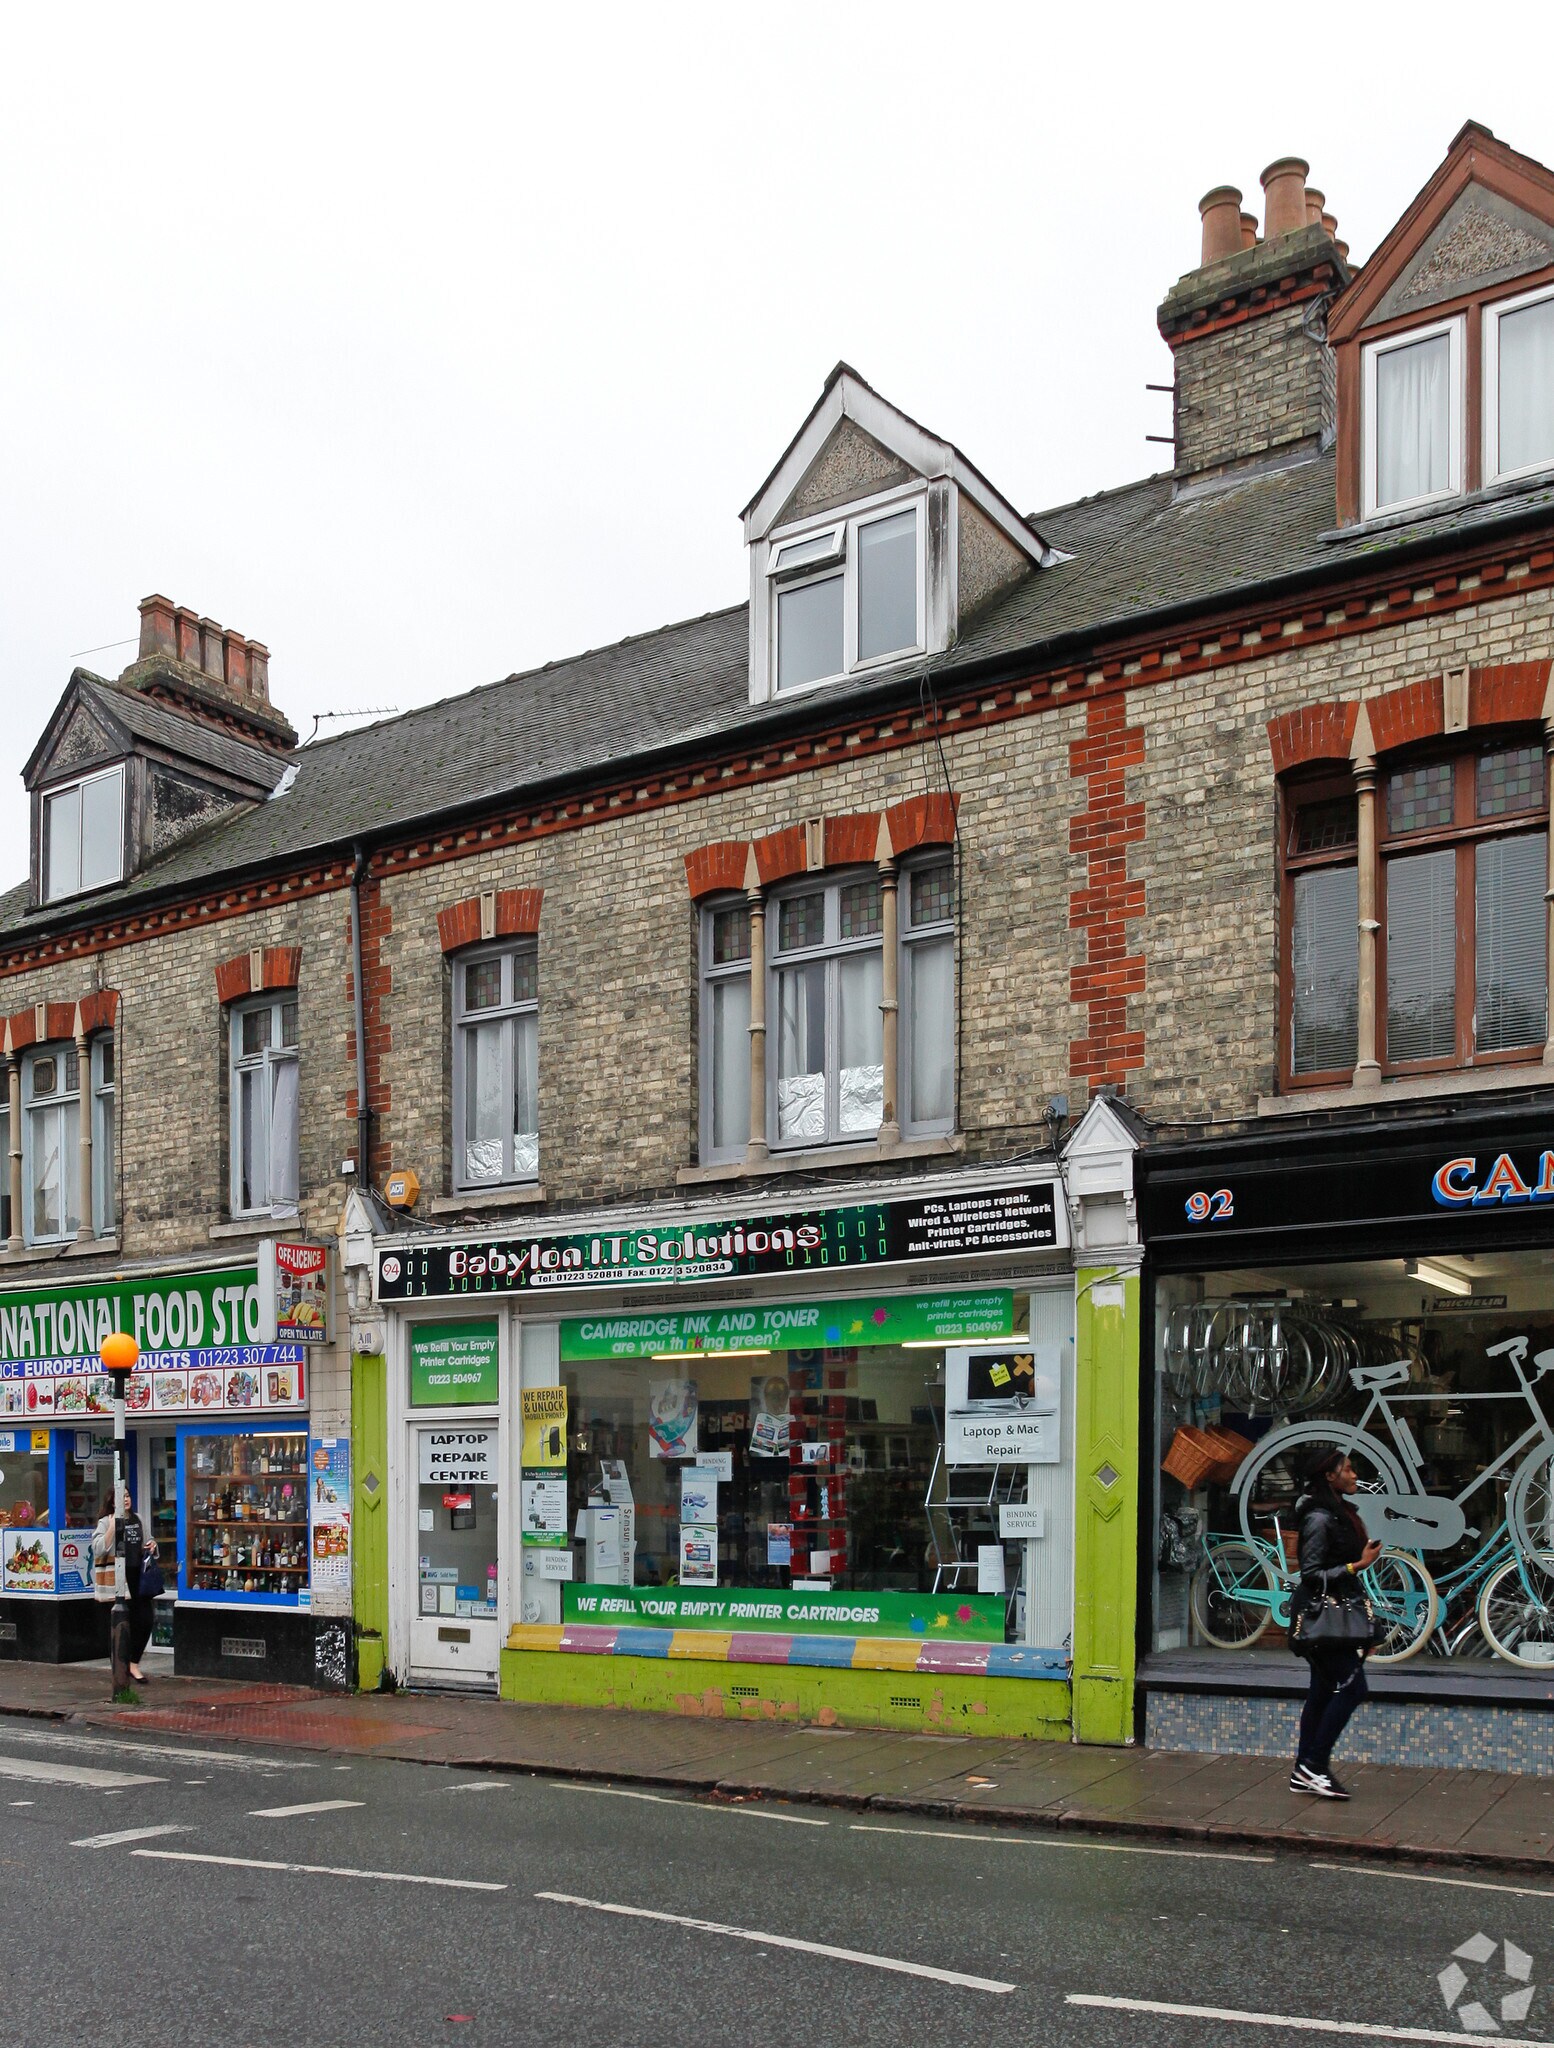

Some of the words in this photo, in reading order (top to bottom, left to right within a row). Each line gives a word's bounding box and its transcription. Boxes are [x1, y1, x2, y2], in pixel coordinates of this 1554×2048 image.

[390, 1183, 404, 1194] ADT
[948, 1199, 992, 1212] Laptops
[1185, 1189, 1234, 1223] 92
[908, 1217, 941, 1227] Wired
[943, 1215, 951, 1224] &
[952, 1210, 1002, 1223] Wireless
[1005, 1204, 1051, 1217] Network
[927, 1226, 966, 1237] Printer
[965, 1235, 979, 1245] PC
[981, 1229, 1052, 1244] Accessories
[278, 1246, 322, 1269] OFF-LICENCE
[449, 1244, 584, 1278] Babylon
[591, 1236, 629, 1266] I.T.
[636, 1226, 822, 1263] Solutions
[384, 1263, 400, 1275] 94
[556, 1271, 585, 1281] 01223
[587, 1269, 623, 1280] 520818
[627, 1268, 647, 1277] Fax:
[649, 1266, 683, 1276] 01223
[686, 1262, 726, 1275] 520834
[916, 1301, 929, 1309] we
[931, 1299, 952, 1308] refill
[952, 1299, 973, 1309] your
[974, 1296, 1004, 1307] empty
[1438, 1297, 1505, 1308] MICHELIN
[133, 1290, 204, 1350] FOOD
[927, 1311, 956, 1322] printer
[958, 1307, 1004, 1320] cartridges
[580, 1318, 678, 1340] CAMBRIDGE
[682, 1316, 713, 1335] INK
[716, 1313, 756, 1331] AND
[763, 1309, 820, 1329] TONER
[935, 1323, 963, 1335] 01223
[965, 1321, 1004, 1333] 504967
[279, 1328, 296, 1338] OPEN
[296, 1329, 309, 1340] TILL
[309, 1330, 323, 1341] LATE
[414, 1343, 429, 1354] We
[430, 1341, 449, 1352] Refill
[451, 1341, 469, 1352] Your
[470, 1340, 495, 1353] Empty
[612, 1341, 635, 1353] are
[640, 1340, 664, 1355] you
[670, 1334, 726, 1352] thinking
[729, 1330, 782, 1350] green?
[0, 1363, 19, 1379] CE
[24, 1356, 103, 1377] EUROPEAN
[198, 1349, 239, 1367] 01223
[243, 1347, 268, 1365] 307
[271, 1345, 297, 1363] 744
[420, 1356, 447, 1367] Printer
[447, 1354, 491, 1367] Cartridges
[428, 1374, 450, 1385] 01223
[452, 1373, 482, 1384] 504967
[523, 1391, 536, 1402] WE
[537, 1389, 564, 1401] REPAIR
[523, 1403, 531, 1413] &
[532, 1401, 565, 1413] UNLOCK
[525, 1412, 545, 1420] MOBILE
[545, 1411, 566, 1419] PHONES
[963, 1425, 1002, 1438] Laptop
[1006, 1426, 1014, 1435] &
[1017, 1424, 1040, 1435] Mac
[430, 1433, 489, 1445] LAPTOP
[431, 1452, 487, 1463] REPAIR
[986, 1444, 1022, 1458] Repair
[429, 1470, 489, 1482] CENTRE
[1006, 1511, 1038, 1519] BINDING
[1006, 1520, 1037, 1528] SERVICE
[60, 1532, 93, 1541] Lycamobil
[64, 1547, 76, 1556] 4G
[545, 1564, 568, 1572] SERVICE
[577, 1597, 598, 1612] WE
[600, 1598, 637, 1613] REFILL
[640, 1600, 676, 1615] YOUR
[680, 1602, 726, 1617] EMPTY
[729, 1603, 782, 1619] PRINTER
[787, 1604, 880, 1623] CARTRIDGES
[450, 1646, 459, 1654] 94
